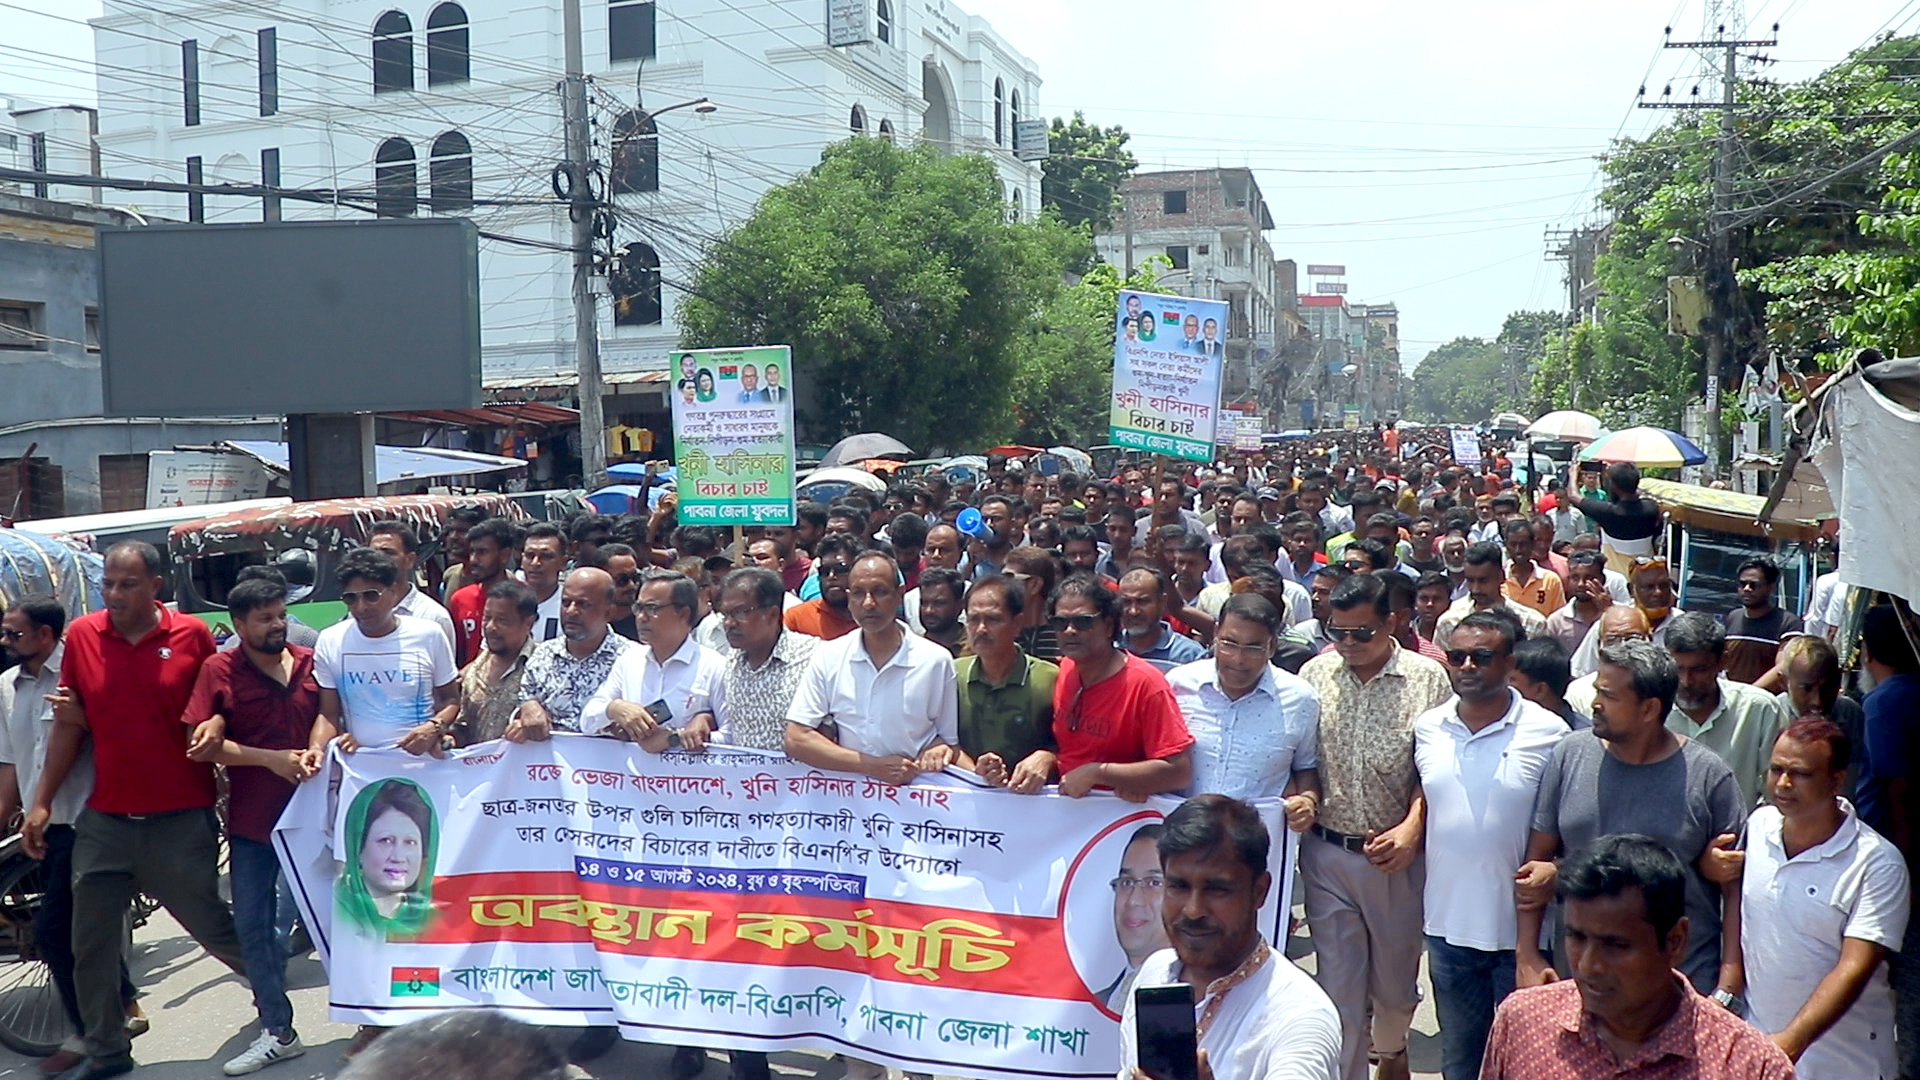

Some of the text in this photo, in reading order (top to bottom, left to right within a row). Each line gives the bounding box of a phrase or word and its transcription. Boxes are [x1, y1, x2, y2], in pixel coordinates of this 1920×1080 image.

[1150, 351, 1166, 359] নেতা
[1159, 362, 1175, 371] নেতা
[1115, 389, 1211, 420] খুনী হাসিনার
[716, 424, 722, 432] ও
[724, 423, 748, 432] সাধারণ
[1129, 410, 1166, 433] বিচার
[1170, 418, 1195, 437] চাই
[1115, 429, 1209, 457] পাবনা জেলা যুবদল
[678, 448, 785, 479] খুনী হাসিনার
[696, 478, 768, 497] বিচার চাই
[683, 503, 789, 522] পাবনা জেলা যুবদল
[348, 669, 413, 685] WAVE
[526, 764, 565, 782] রক্তে
[572, 768, 625, 791] ভেজা
[631, 773, 733, 800] বাংলাদেশে,
[740, 772, 779, 801] খুনি
[785, 770, 856, 798] হাসিনার
[585, 799, 634, 823] উপর
[641, 804, 675, 827] গুলি
[680, 806, 741, 829] চালিয়ে
[749, 808, 856, 834] গণহত্যাকারী
[861, 813, 895, 841] খুনি
[901, 819, 1005, 854] হাসিনাসহ
[516, 826, 547, 843] তার
[641, 832, 711, 857] বিচারের
[717, 836, 778, 859] দাবীতে
[879, 844, 962, 876] উদ্যোগে
[579, 861, 859, 895] ১৪ ও ১৫ আগস্ট ২০২৪, বুধ ও বৃহস্পতিবার
[468, 894, 1015, 982] অবস্থান কর্মসূচি
[451, 965, 556, 992] বাংলাদেশ
[698, 984, 847, 1028] দল-বিএনপি,
[859, 1003, 927, 1042] পাবনা
[938, 1017, 1013, 1050] জেলা
[1021, 1025, 1091, 1057] শাখা
